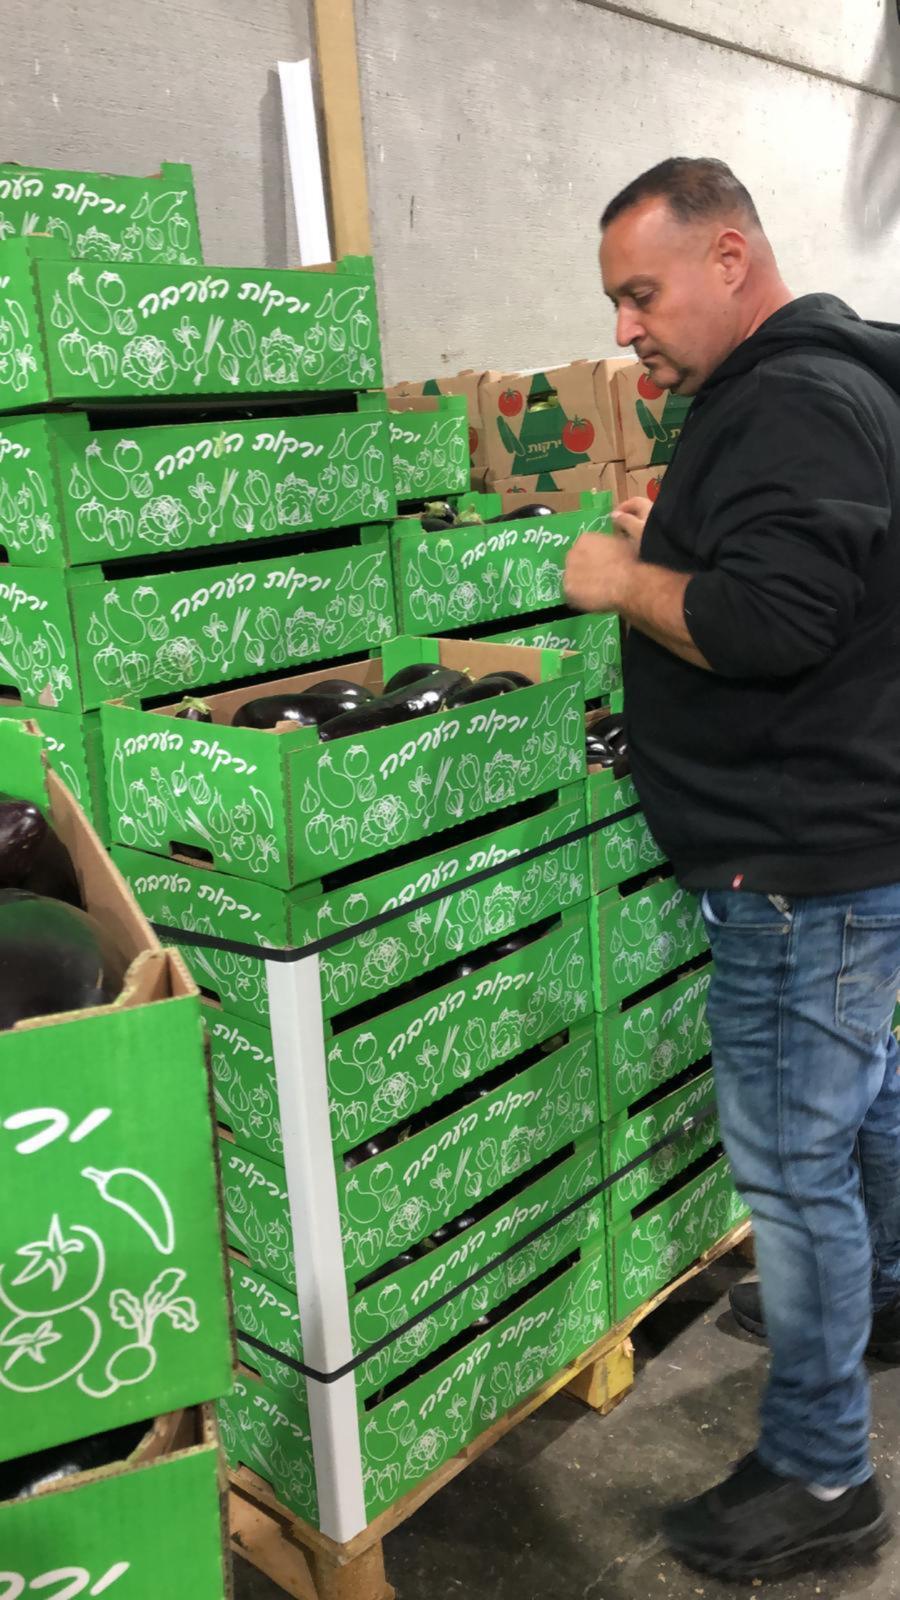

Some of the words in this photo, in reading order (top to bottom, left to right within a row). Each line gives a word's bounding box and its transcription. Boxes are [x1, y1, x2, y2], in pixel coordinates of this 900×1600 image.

[0, 175, 43, 200] הער
[52, 183, 126, 215] ירקות
[138, 275, 229, 318] הערבה
[237, 281, 311, 316] ירקות
[154, 431, 243, 480] הערבה
[252, 430, 323, 464] ירקות
[461, 528, 518, 569] הערבה
[523, 525, 569, 557] ירקות
[171, 573, 256, 622] הערבה
[264, 567, 331, 599] ירקות
[123, 730, 183, 757] הערבה
[467, 709, 528, 743] ירקות
[190, 735, 256, 775] ירקות
[379, 720, 459, 780] הערבה
[135, 875, 190, 894] הערבה
[198, 883, 261, 922] ירקות
[473, 972, 533, 1005] ירקות
[661, 974, 711, 1029] הערבה
[213, 1023, 273, 1063] ירקות
[387, 990, 465, 1060] הערבה
[485, 1088, 542, 1123] ירקות
[663, 1077, 714, 1134] הערבה
[403, 1114, 477, 1186] הערבה
[228, 1156, 288, 1199] ירקות
[492, 1200, 548, 1238] ירקות
[668, 1172, 717, 1231] הערבה
[412, 1231, 485, 1305] הערבה
[240, 1276, 300, 1320] ירקות
[498, 1308, 554, 1347] ירקות
[420, 1342, 491, 1420] הערבה
[253, 1396, 311, 1441] ירקות
